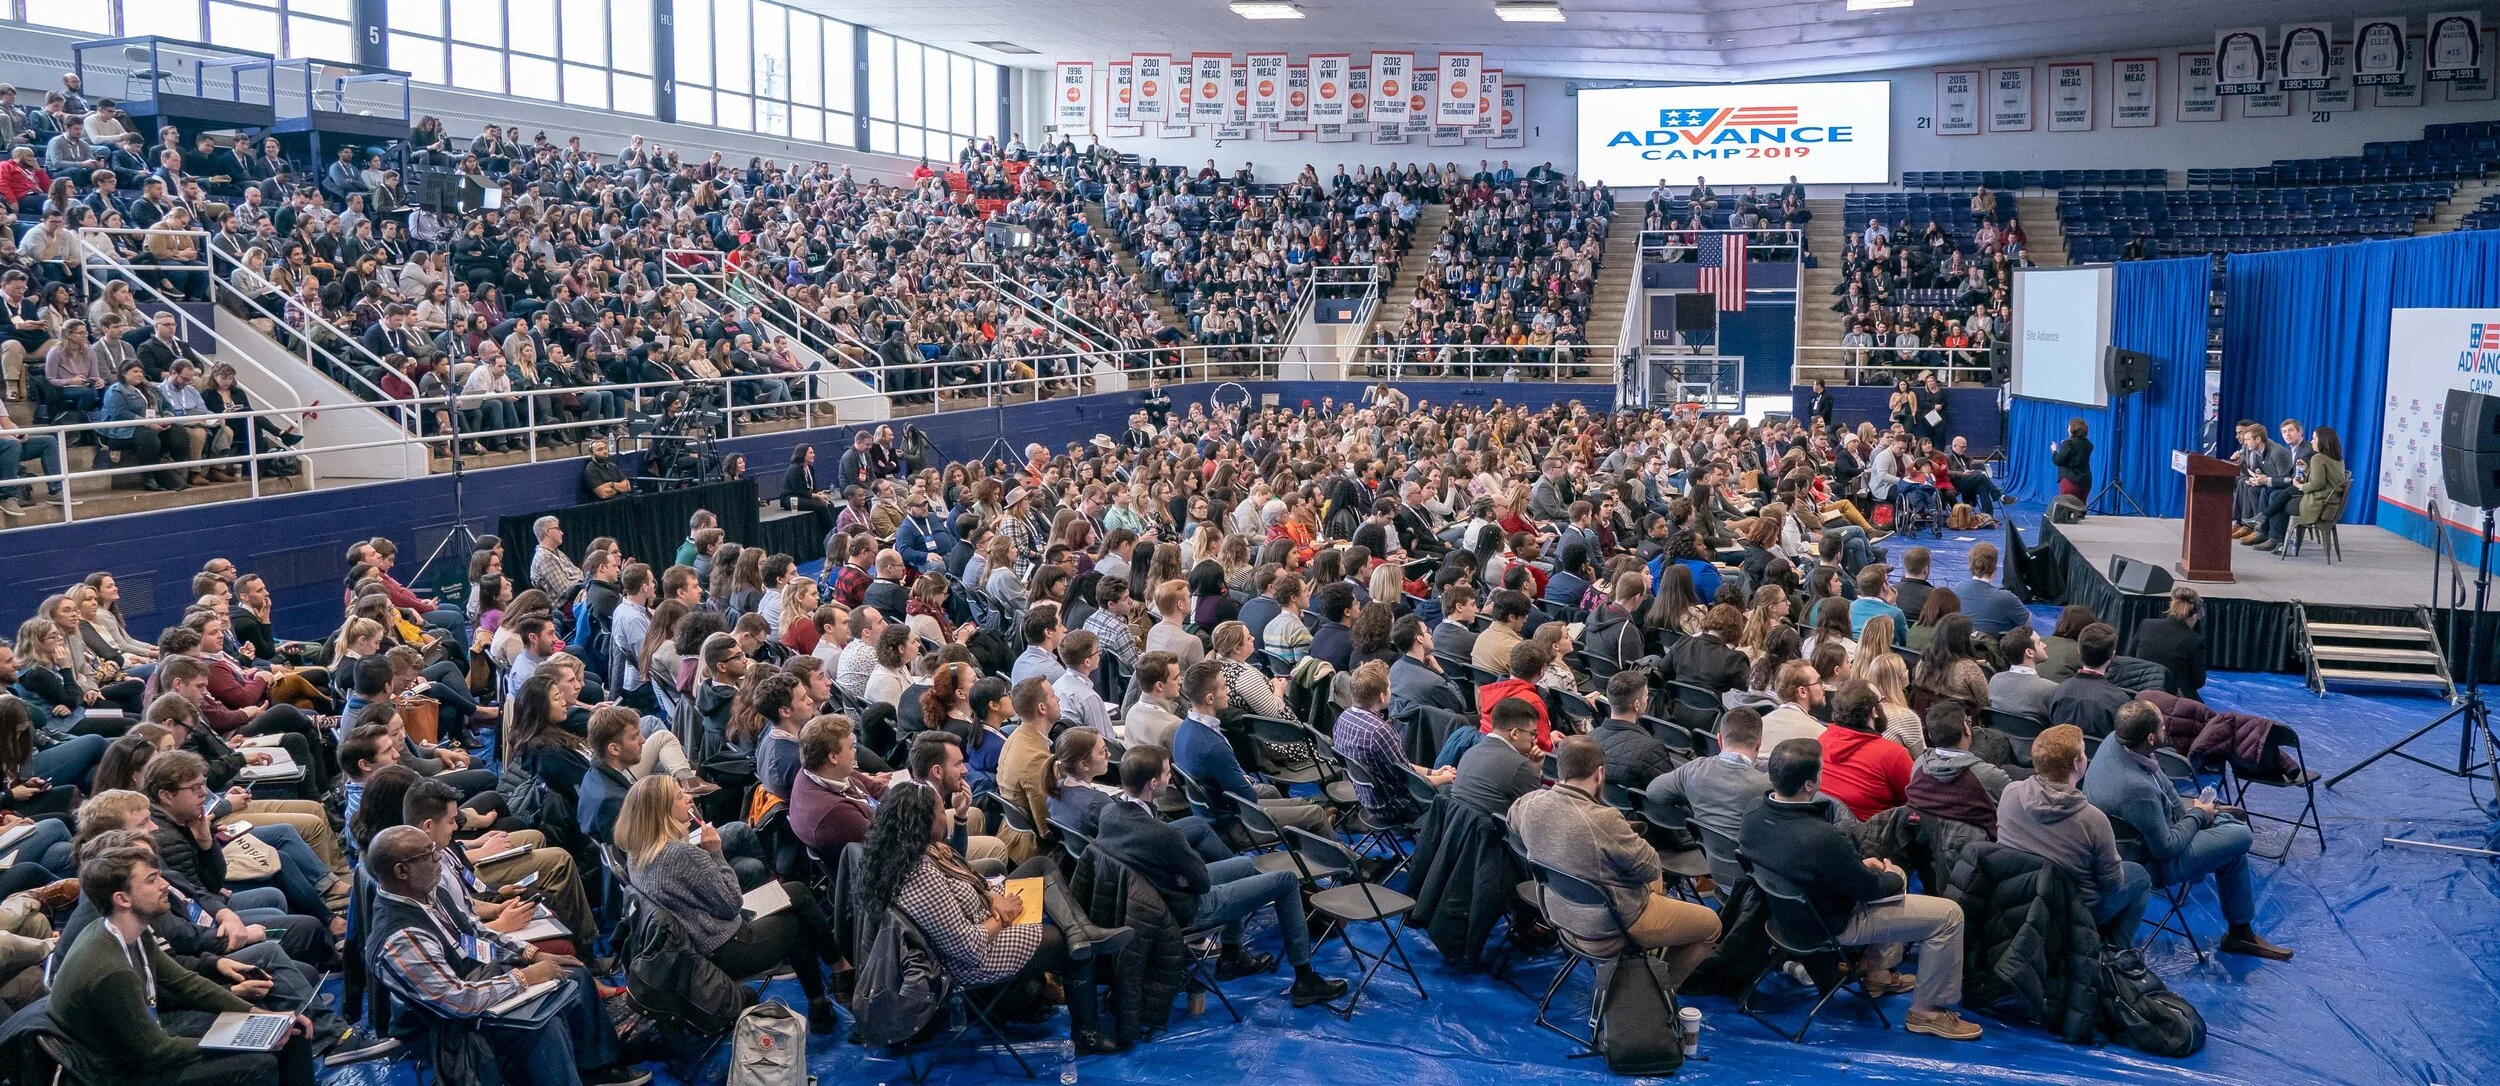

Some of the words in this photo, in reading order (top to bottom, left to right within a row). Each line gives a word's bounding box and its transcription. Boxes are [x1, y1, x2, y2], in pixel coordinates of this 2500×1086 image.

[660, 13, 673, 26] HU
[369, 25, 380, 45] 5
[1143, 59, 1159, 67] 2001
[1203, 60, 1220, 69] 2001
[1252, 58, 1282, 67] 2001-02
[1321, 60, 1337, 69] 2011
[1383, 57, 1401, 66] 2012
[1451, 58, 1470, 67] 2013
[2193, 58, 2210, 67] 1991
[1067, 67, 1082, 75] 1996
[1120, 67, 1131, 76] 199
[1141, 68, 1159, 77] NCAA
[1180, 67, 1191, 75] 199
[1256, 68, 1277, 77] MEAC
[1382, 67, 1401, 76] WNIT
[1453, 68, 1467, 77] CBI
[2126, 64, 2144, 73] 1993
[2190, 67, 2212, 76] MEAC
[1201, 70, 1221, 78] MEAC
[1290, 70, 1307, 78] 1998
[1320, 70, 1338, 78] WNIT
[1350, 72, 1366, 80] 1998
[1412, 73, 1436, 82] 9-2000
[2001, 72, 2020, 80] 2015
[2062, 69, 2080, 78] 1994
[2124, 73, 2146, 82] MEAC
[1066, 76, 1083, 84] MEAC
[1289, 79, 1308, 87] MEAC
[1949, 75, 1967, 85] 2015
[2060, 78, 2082, 87] MEAC
[2284, 79, 2326, 89] 1993-1997
[2357, 75, 2400, 85] 1993-1996
[663, 79, 671, 95] 4
[1348, 81, 1367, 89] NCAA
[1947, 85, 1968, 94] NCAA
[2000, 81, 2022, 90] MEAC
[2220, 84, 2260, 94] 1991-1994
[1502, 98, 1515, 106] EAC
[2311, 111, 2331, 123] 20
[862, 116, 867, 129] 3
[1916, 117, 1931, 129] 21
[1534, 125, 1540, 137] 1
[1606, 125, 1853, 147] ADVANCE
[1215, 139, 1222, 148] 2
[1653, 329, 1669, 339] HU
[2026, 330, 2036, 341] Site
[2037, 330, 2060, 342] Advance
[2457, 350, 2500, 376] ADVANC
[2469, 378, 2493, 394] CAMP
